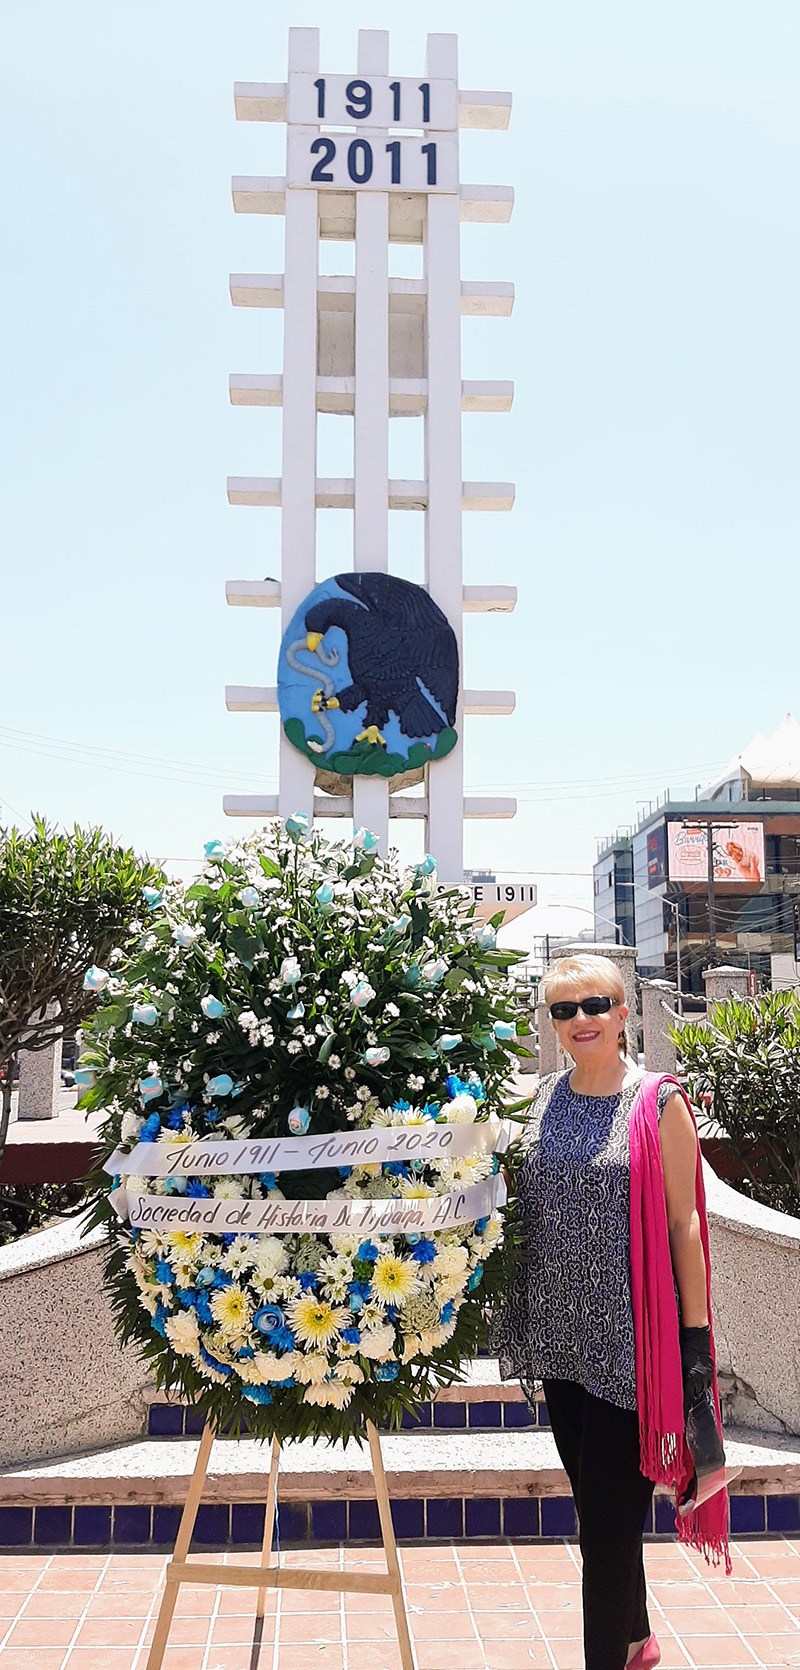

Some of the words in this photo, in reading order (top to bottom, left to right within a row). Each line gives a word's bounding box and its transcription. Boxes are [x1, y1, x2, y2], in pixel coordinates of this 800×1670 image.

[313, 78, 431, 123] 1911
[310, 137, 437, 185] 2011
[497, 886, 533, 901] 1911
[232, 1142, 281, 1166] 1911
[386, 1130, 453, 1151] 2020
[131, 1196, 222, 1224] Sociedad
[225, 1201, 252, 1225] de
[256, 1200, 328, 1229] Historia
[432, 1194, 466, 1225] A.C.
